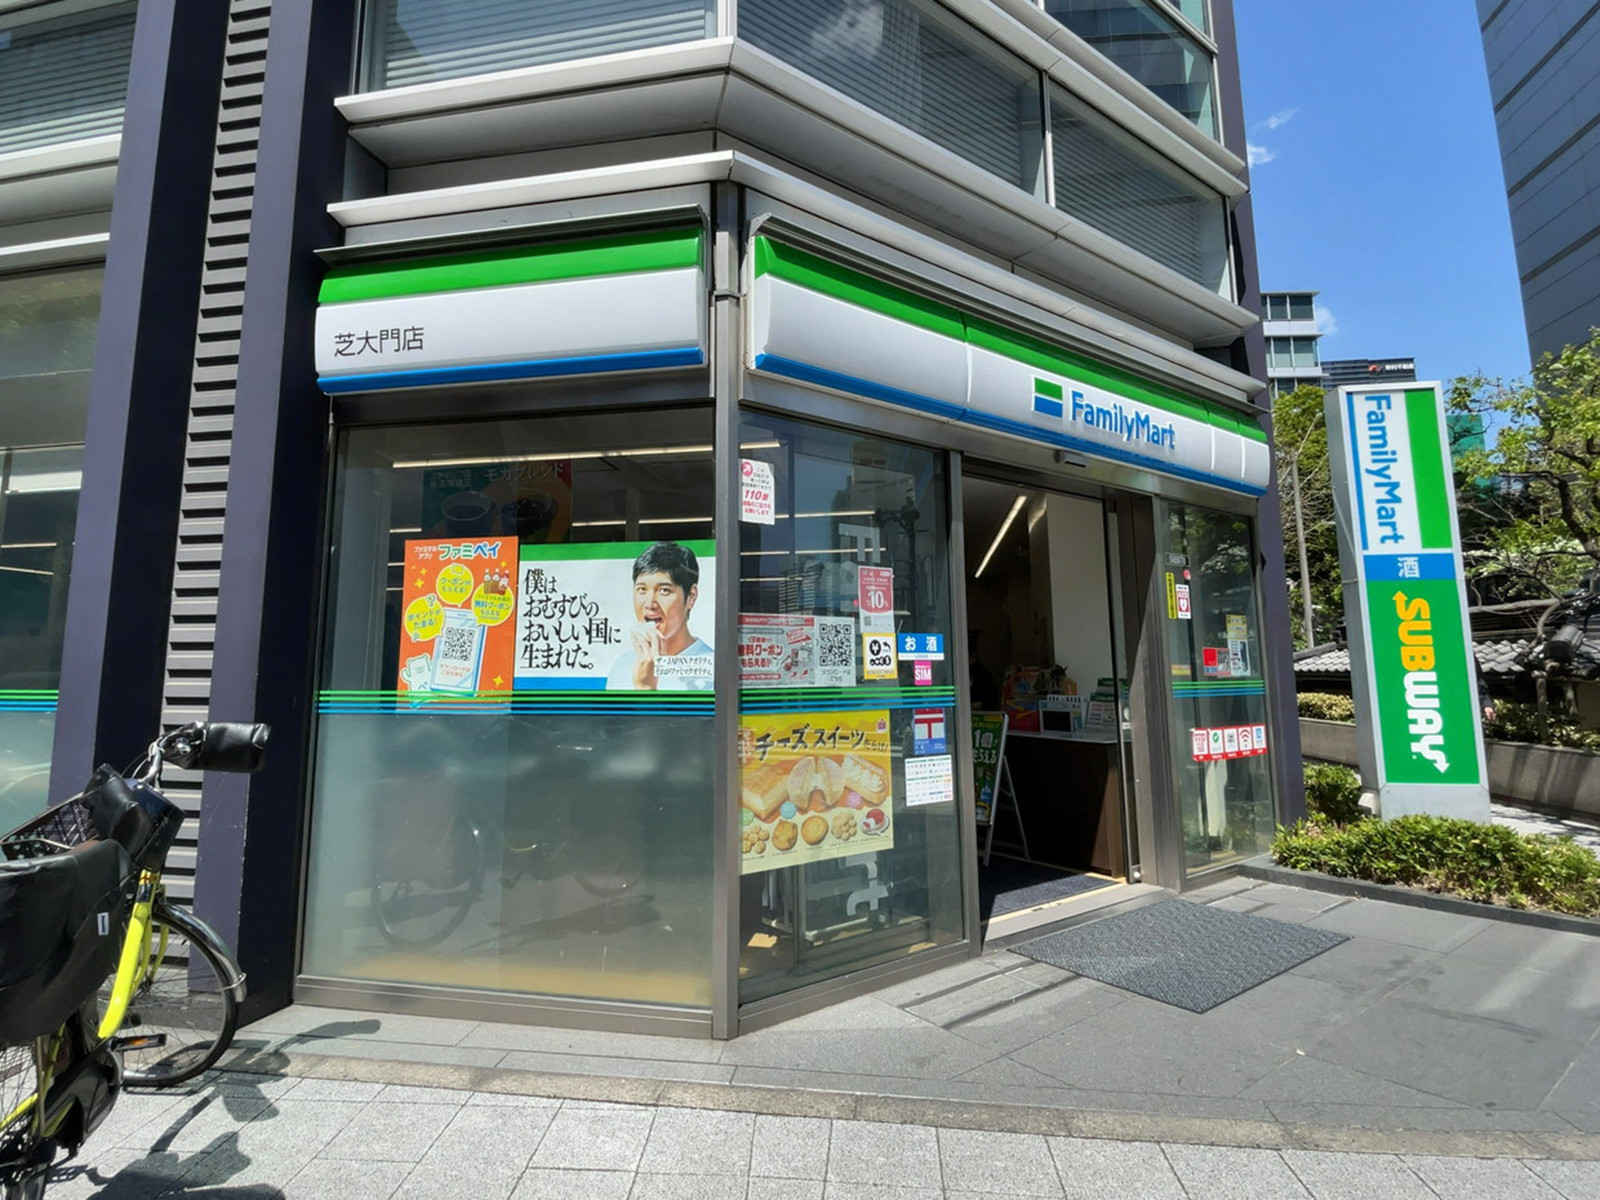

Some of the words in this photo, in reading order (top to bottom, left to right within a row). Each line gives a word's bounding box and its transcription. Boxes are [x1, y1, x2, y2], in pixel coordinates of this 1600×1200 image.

[334, 326, 424, 357] 芝大門店
[1071, 389, 1175, 449] FamilyMart
[1364, 395, 1405, 544] FamilyMart
[438, 541, 501, 560] ファミペイ
[1397, 556, 1420, 578] 酒
[523, 568, 557, 595] 僕は
[523, 593, 600, 619] おむすびの
[522, 617, 622, 645] おいしい国に
[904, 635, 938, 652] お酒
[520, 643, 594, 670] 生まれた。
[915, 668, 932, 680] SIM
[1393, 591, 1450, 773] SUBWAY
